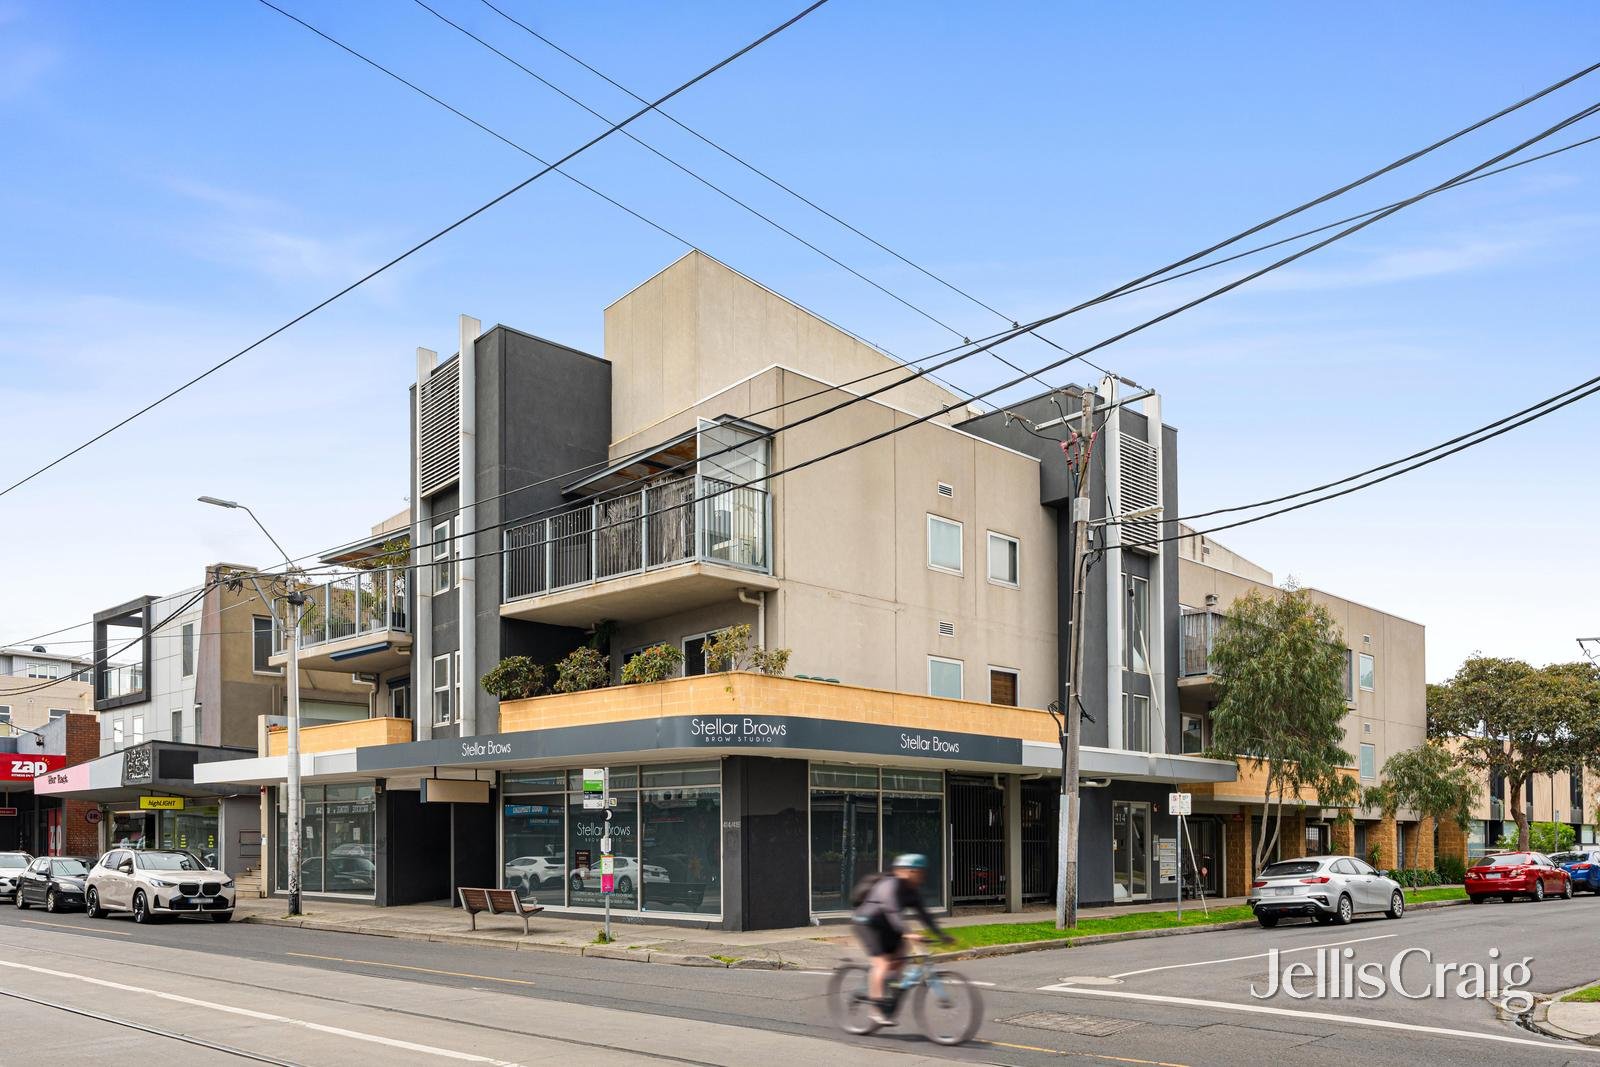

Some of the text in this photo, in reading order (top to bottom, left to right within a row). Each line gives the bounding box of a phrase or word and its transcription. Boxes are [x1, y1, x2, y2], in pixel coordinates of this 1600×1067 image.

[691, 718, 787, 736] Stellar Brows
[462, 741, 511, 757] Stellar Brows
[900, 733, 960, 753] Stellar Brows
[11, 760, 47, 778] zap
[148, 799, 176, 808] highLIGHT
[577, 822, 603, 836] Stellar
